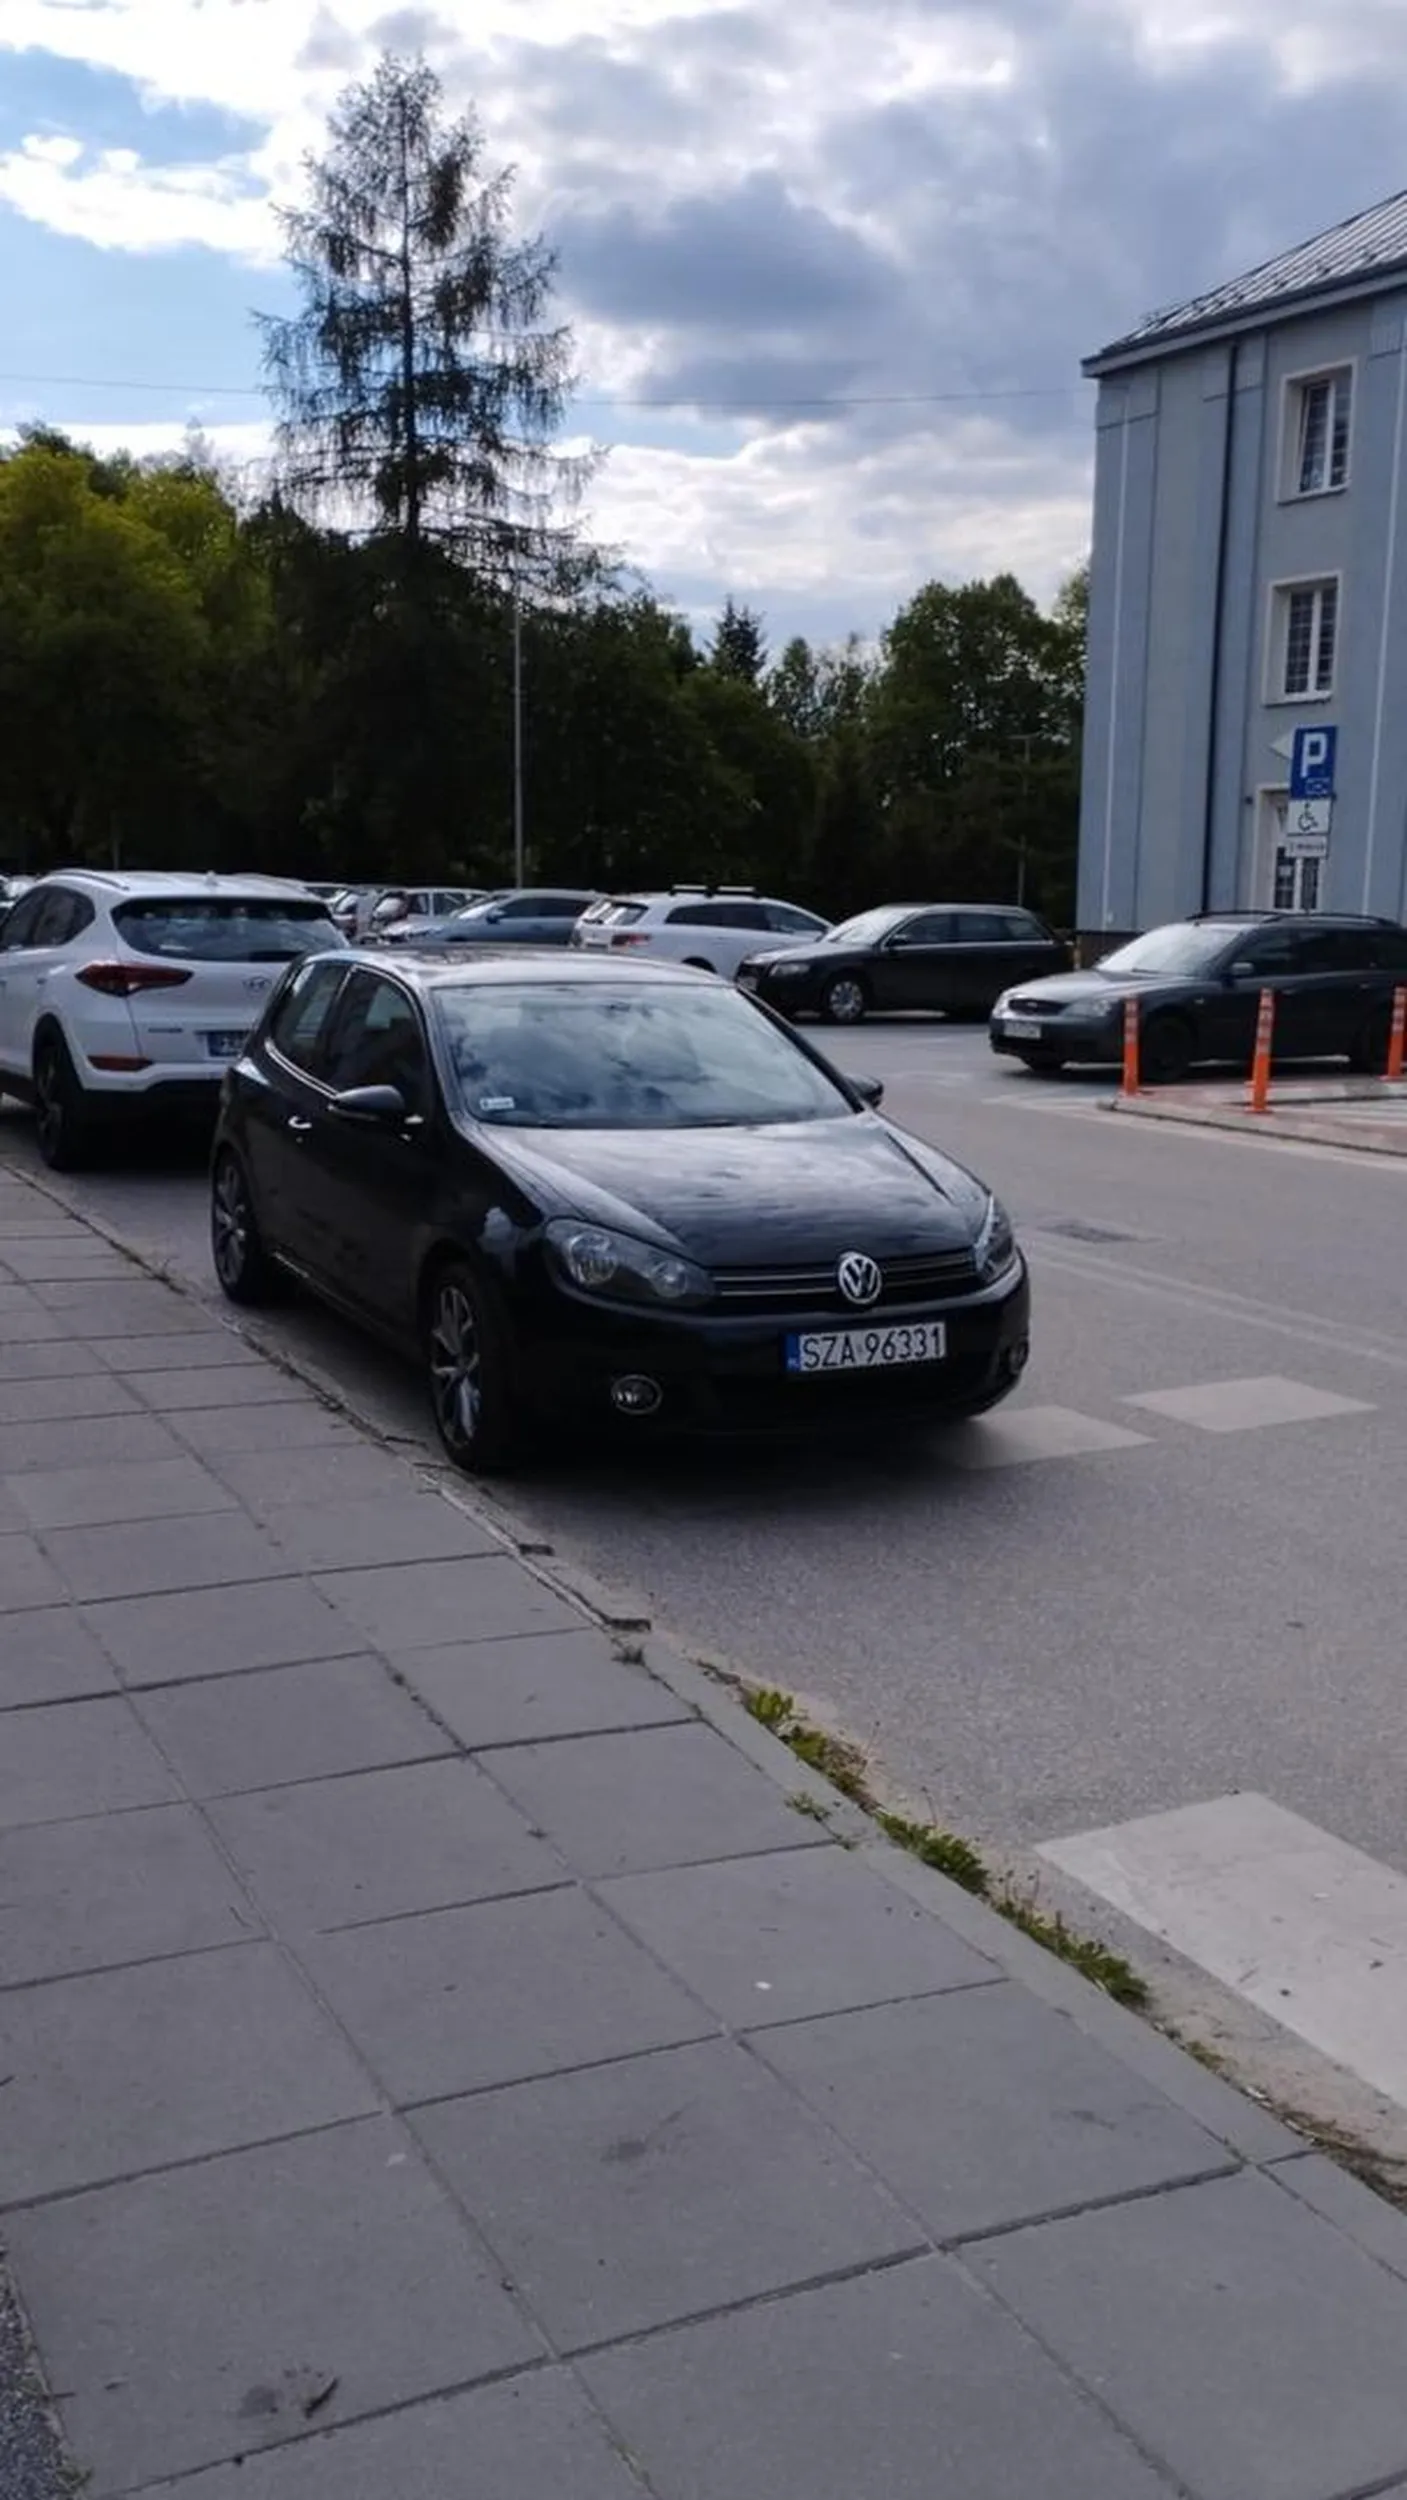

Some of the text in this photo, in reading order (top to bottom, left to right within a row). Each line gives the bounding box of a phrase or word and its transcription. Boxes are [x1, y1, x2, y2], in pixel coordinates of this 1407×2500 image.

[1301, 731, 1328, 778] P
[803, 1326, 942, 1369] SZA 96331
